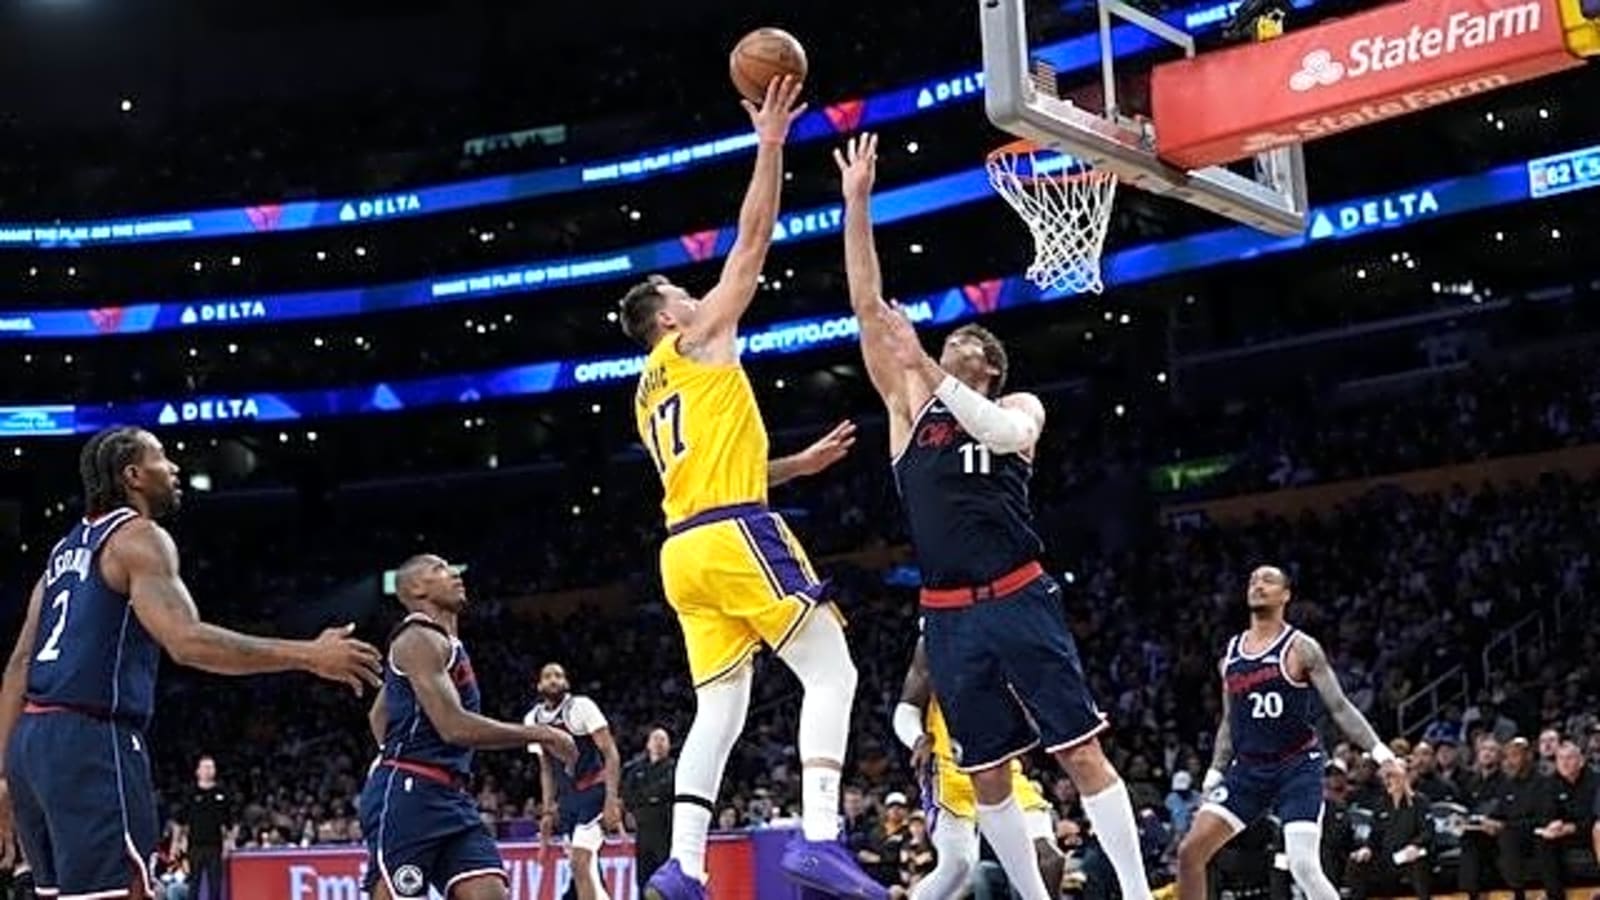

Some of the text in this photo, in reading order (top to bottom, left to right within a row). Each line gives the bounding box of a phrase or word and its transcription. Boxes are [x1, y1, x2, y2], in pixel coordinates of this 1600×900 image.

[936, 71, 984, 101] DELT
[359, 195, 420, 217] DELTA
[1340, 191, 1439, 230] DELTA
[789, 209, 842, 236] DELT
[201, 301, 265, 321] DELTA
[182, 398, 258, 421] DELTA
[649, 391, 687, 473] 17
[958, 442, 991, 474] 11
[36, 589, 70, 661] 2
[1248, 691, 1284, 719] 20
